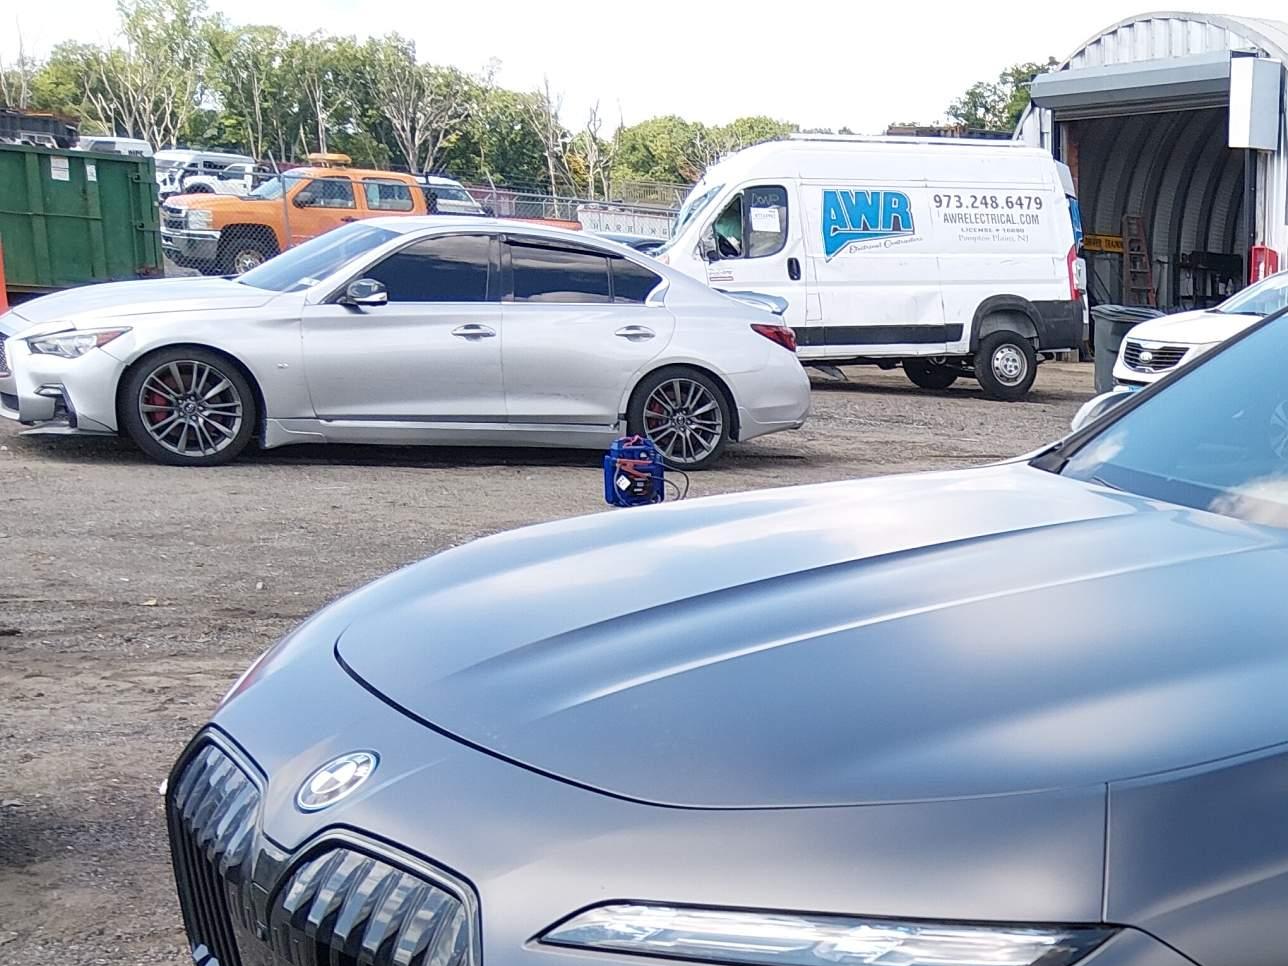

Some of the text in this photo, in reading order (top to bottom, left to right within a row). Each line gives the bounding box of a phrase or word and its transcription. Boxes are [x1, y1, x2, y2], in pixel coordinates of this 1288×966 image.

[933, 194, 1043, 210] 973.248.6479
[822, 189, 914, 236] AWR
[943, 213, 1040, 225] AWRELECTRICAL.COM
